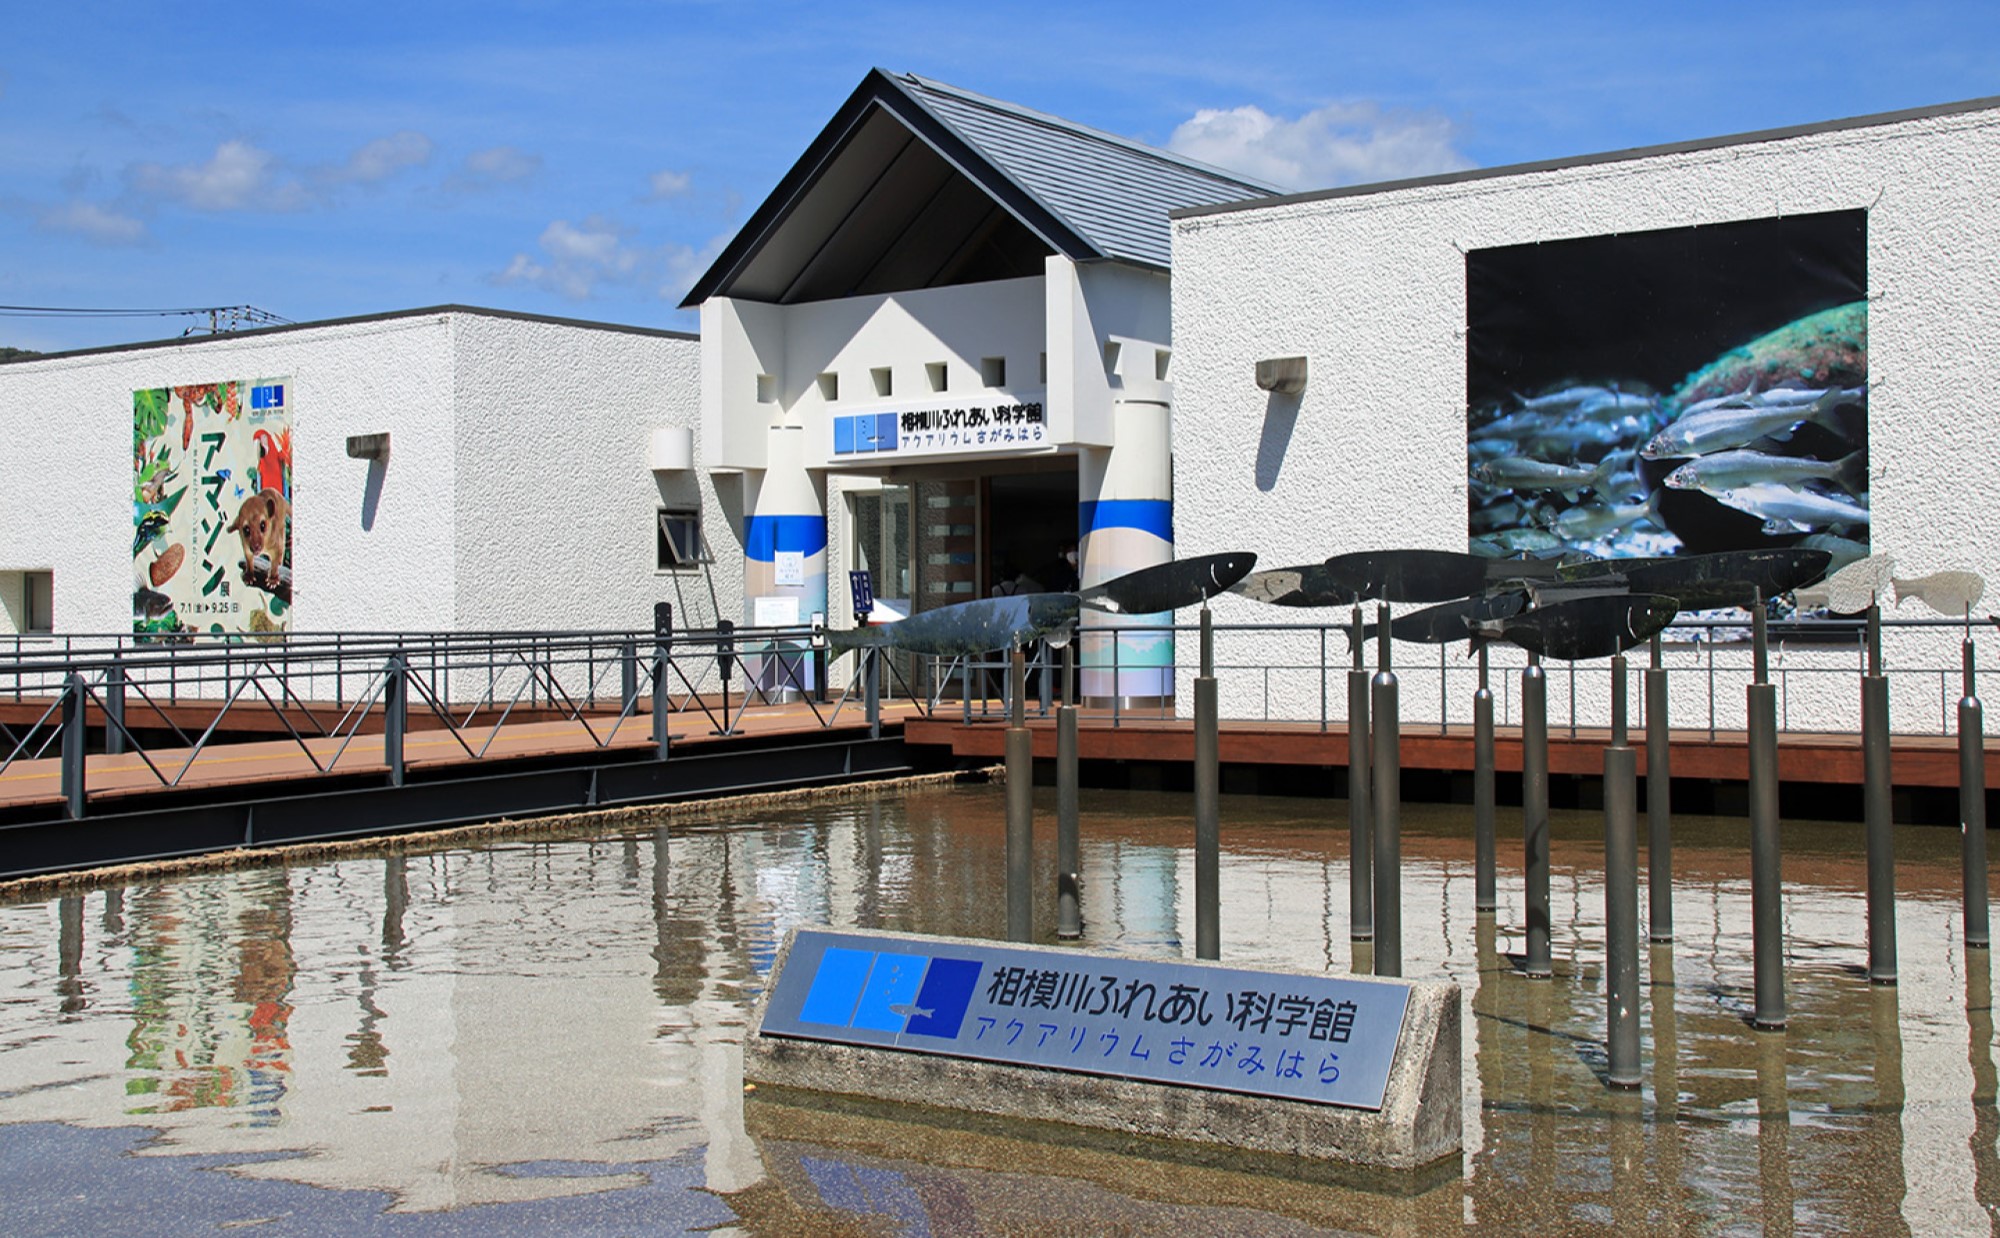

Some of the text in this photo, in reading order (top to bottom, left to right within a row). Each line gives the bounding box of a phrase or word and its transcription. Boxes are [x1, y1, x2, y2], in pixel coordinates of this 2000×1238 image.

[901, 402, 1043, 432] 相模川ふれあい科学館
[987, 966, 1358, 1044] 相模川ふれあい科学館
